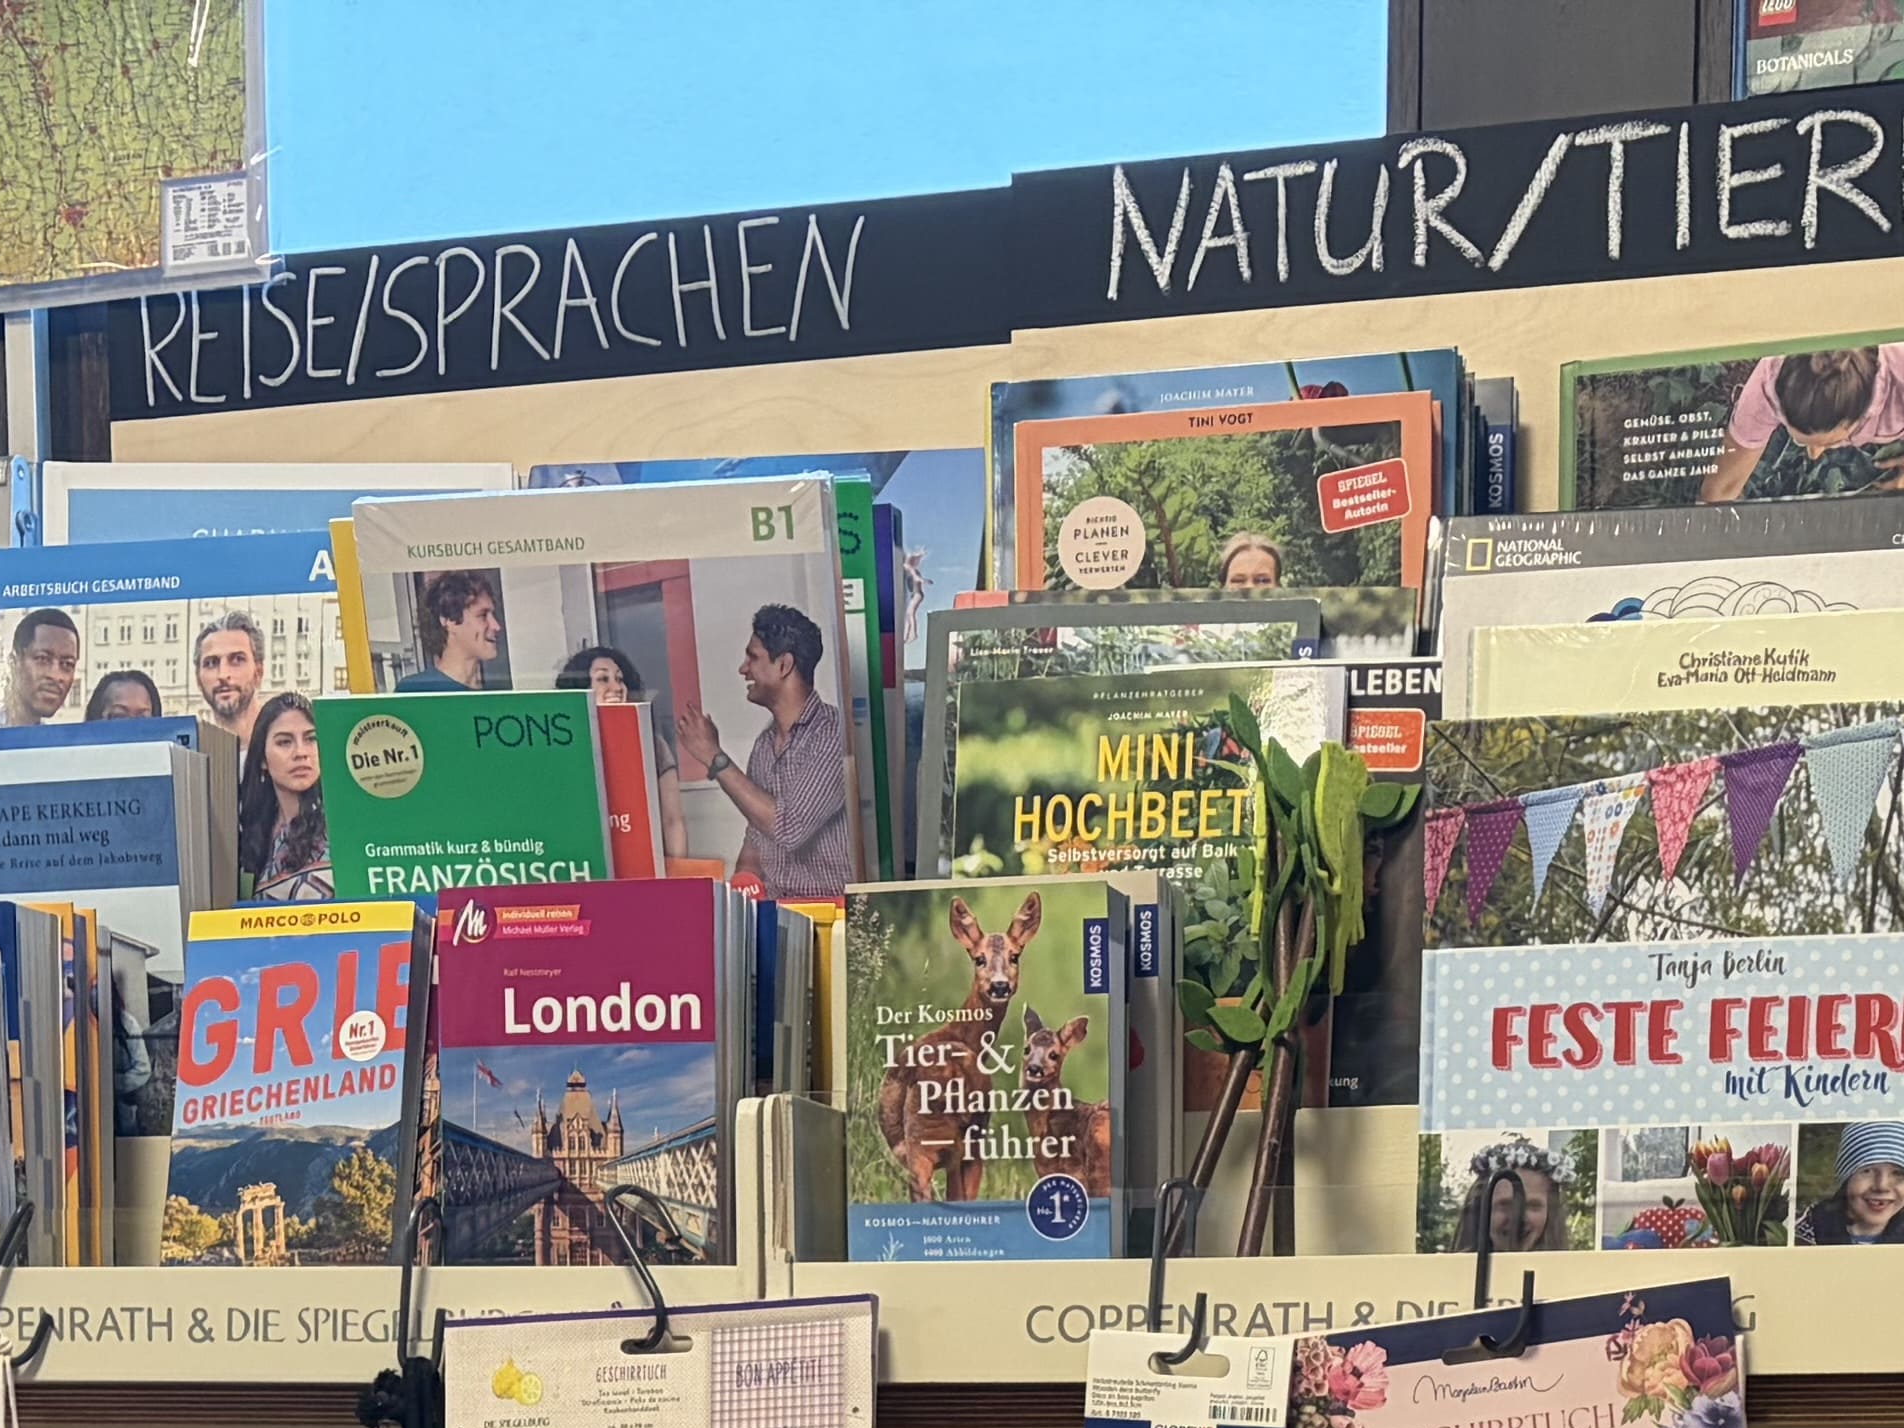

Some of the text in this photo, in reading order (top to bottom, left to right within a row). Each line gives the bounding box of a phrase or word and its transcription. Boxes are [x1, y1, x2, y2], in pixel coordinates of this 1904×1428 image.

[1756, 47, 1857, 75] BOTANICALS
[140, 213, 865, 406] REISE/SPRACHEN
[1160, 386, 1255, 404] JOACHIM MAYER
[1188, 413, 1254, 429] TINI VOGT
[1622, 446, 1725, 465] SELBST ANBAUEN
[1489, 431, 1505, 509] KOSMOS
[1622, 463, 1719, 483] DAS GANZE JAHR
[750, 505, 797, 542] B1
[1072, 525, 1130, 541] PLANEN
[406, 534, 585, 560] KURSBUCH GESAMTBAND
[1074, 549, 1129, 564] CLEVER
[1496, 538, 1566, 554] NATIONAL
[1496, 550, 1583, 568] GEOGRAPHIC
[2, 574, 181, 598] ARBEITSBUCH GESAMTBAND
[1678, 648, 1810, 670] Christiane Kutik
[1657, 668, 1728, 689] Eva-Maria
[472, 712, 574, 749] PONS
[1097, 731, 1195, 783] MINI
[36, 798, 144, 822] KERKELING
[1013, 789, 1250, 845] HOCHBEET
[1, 828, 41, 848] dann
[45, 826, 76, 846] mal
[77, 827, 110, 851] weg
[364, 837, 545, 859] Grammatik kurz & bündig
[367, 857, 593, 895] FRANZÖSISCH
[239, 910, 362, 930] MARCO POLO
[1140, 910, 1153, 972] KOSMOS
[1089, 924, 1103, 989] KOSMOS
[1648, 947, 1788, 989] Tanja Berlin
[503, 982, 702, 1036] London
[876, 1003, 994, 1025] Der Kosmos
[1490, 999, 1685, 1073] FESTE
[875, 1030, 1016, 1076] Tier- &
[182, 1063, 397, 1125] GRIECHENLAND
[916, 1079, 1074, 1115] Pflanzen
[1725, 1064, 1891, 1108] mit Kindern
